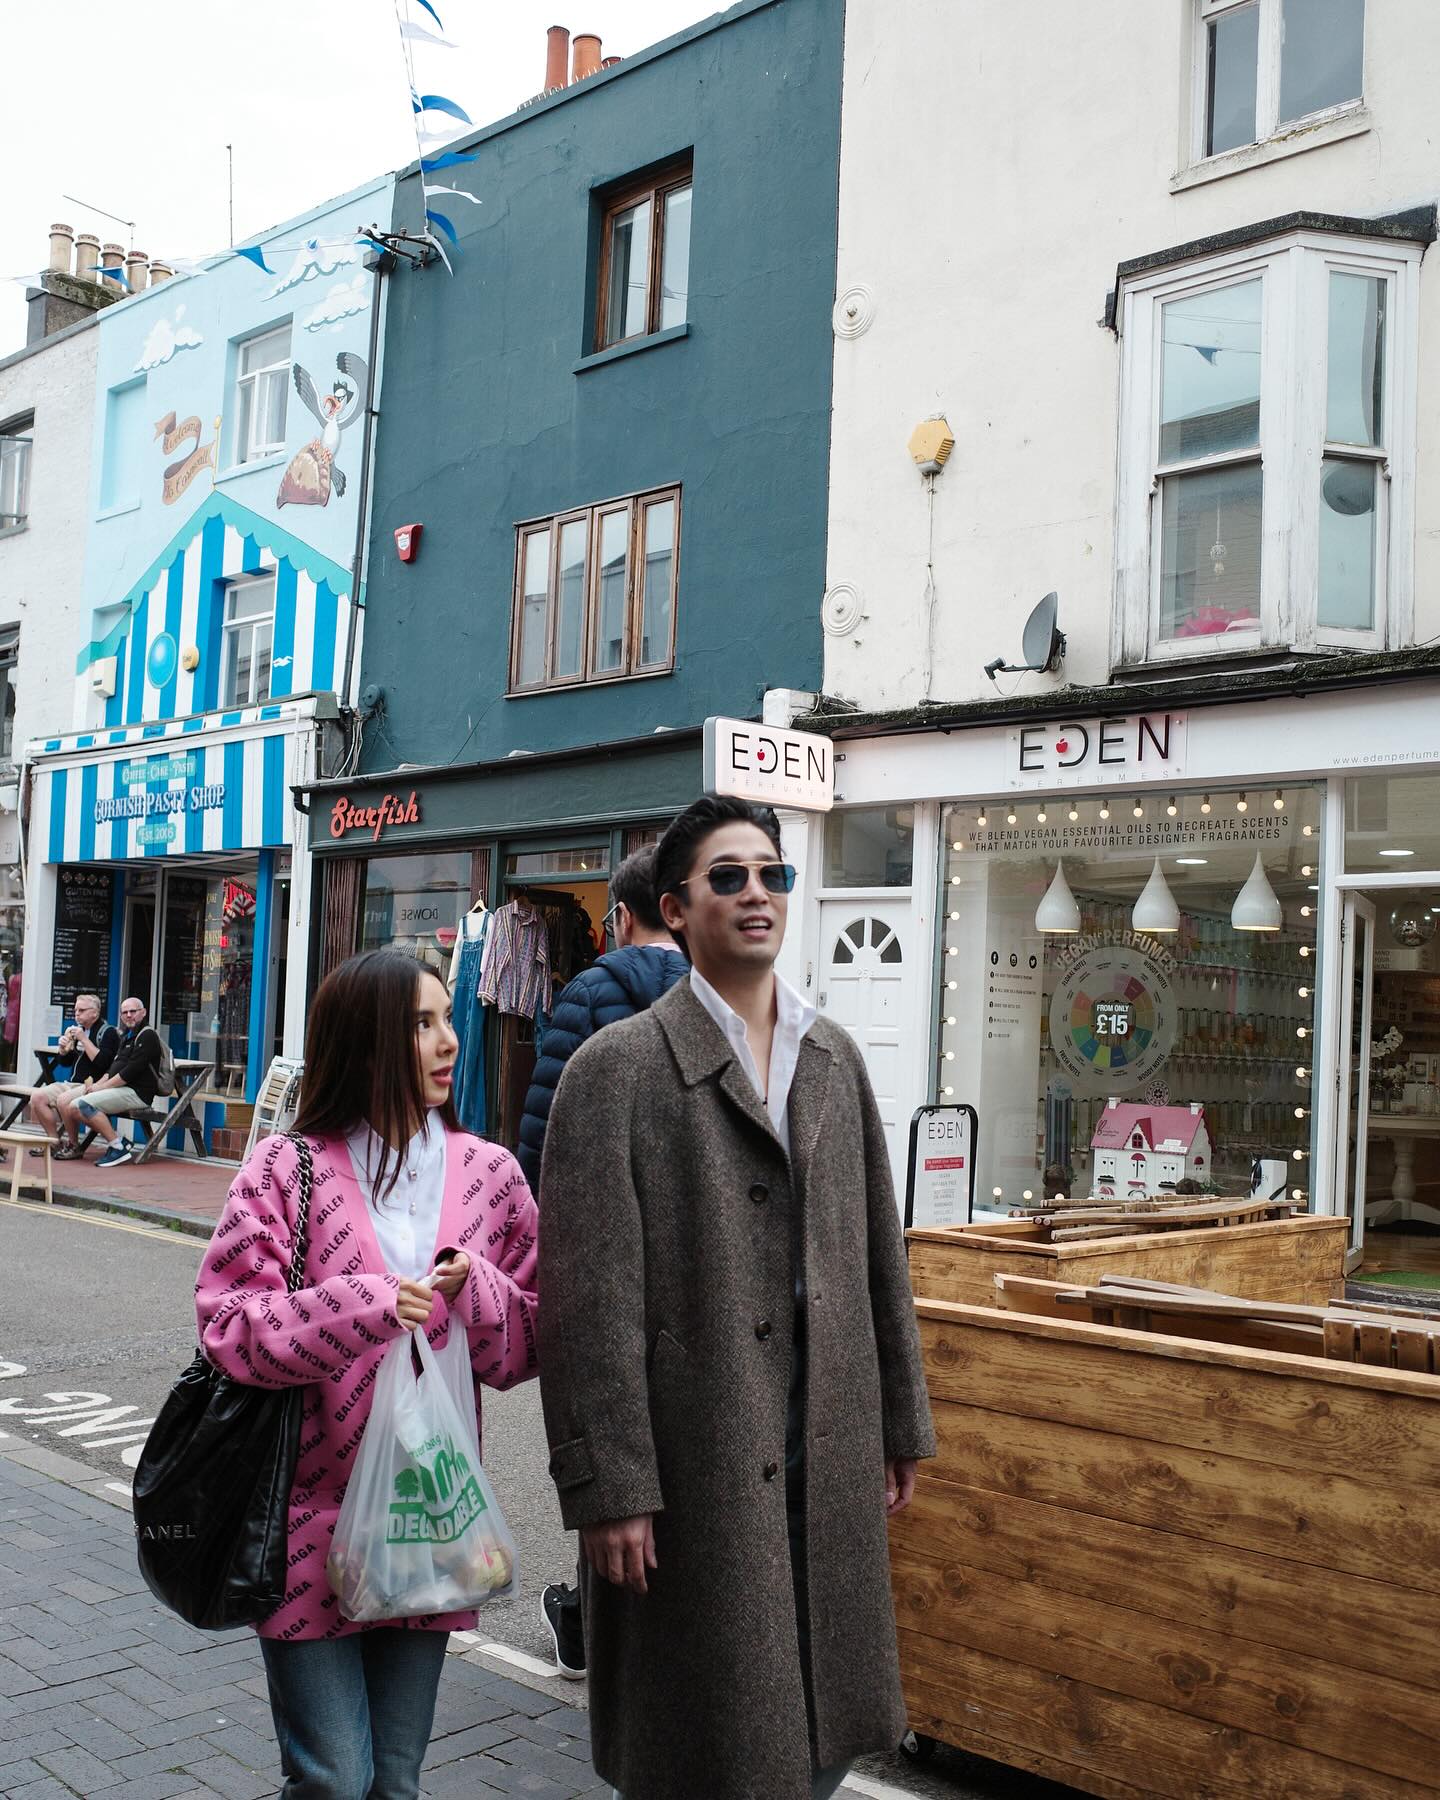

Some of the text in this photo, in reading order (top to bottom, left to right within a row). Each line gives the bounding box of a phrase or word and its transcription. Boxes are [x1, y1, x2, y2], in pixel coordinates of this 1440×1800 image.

[1019, 714, 1170, 771] EDEN
[732, 732, 825, 783] EDEN
[94, 795, 145, 824] CORNISH
[146, 789, 188, 816] PASTY
[330, 790, 419, 842] Starfish
[969, 816, 1288, 842] WE BLEND VEGAN ESSENTIAL OILS TO RECREATE SCENTS
[975, 828, 1280, 852] THAT MATCH YOUR FAVOURITE DESIGNER FRAGRANCES
[1096, 1004, 1130, 1012] FROM ONLY
[1096, 1014, 1128, 1035] £15
[928, 1122, 963, 1140] EDEN
